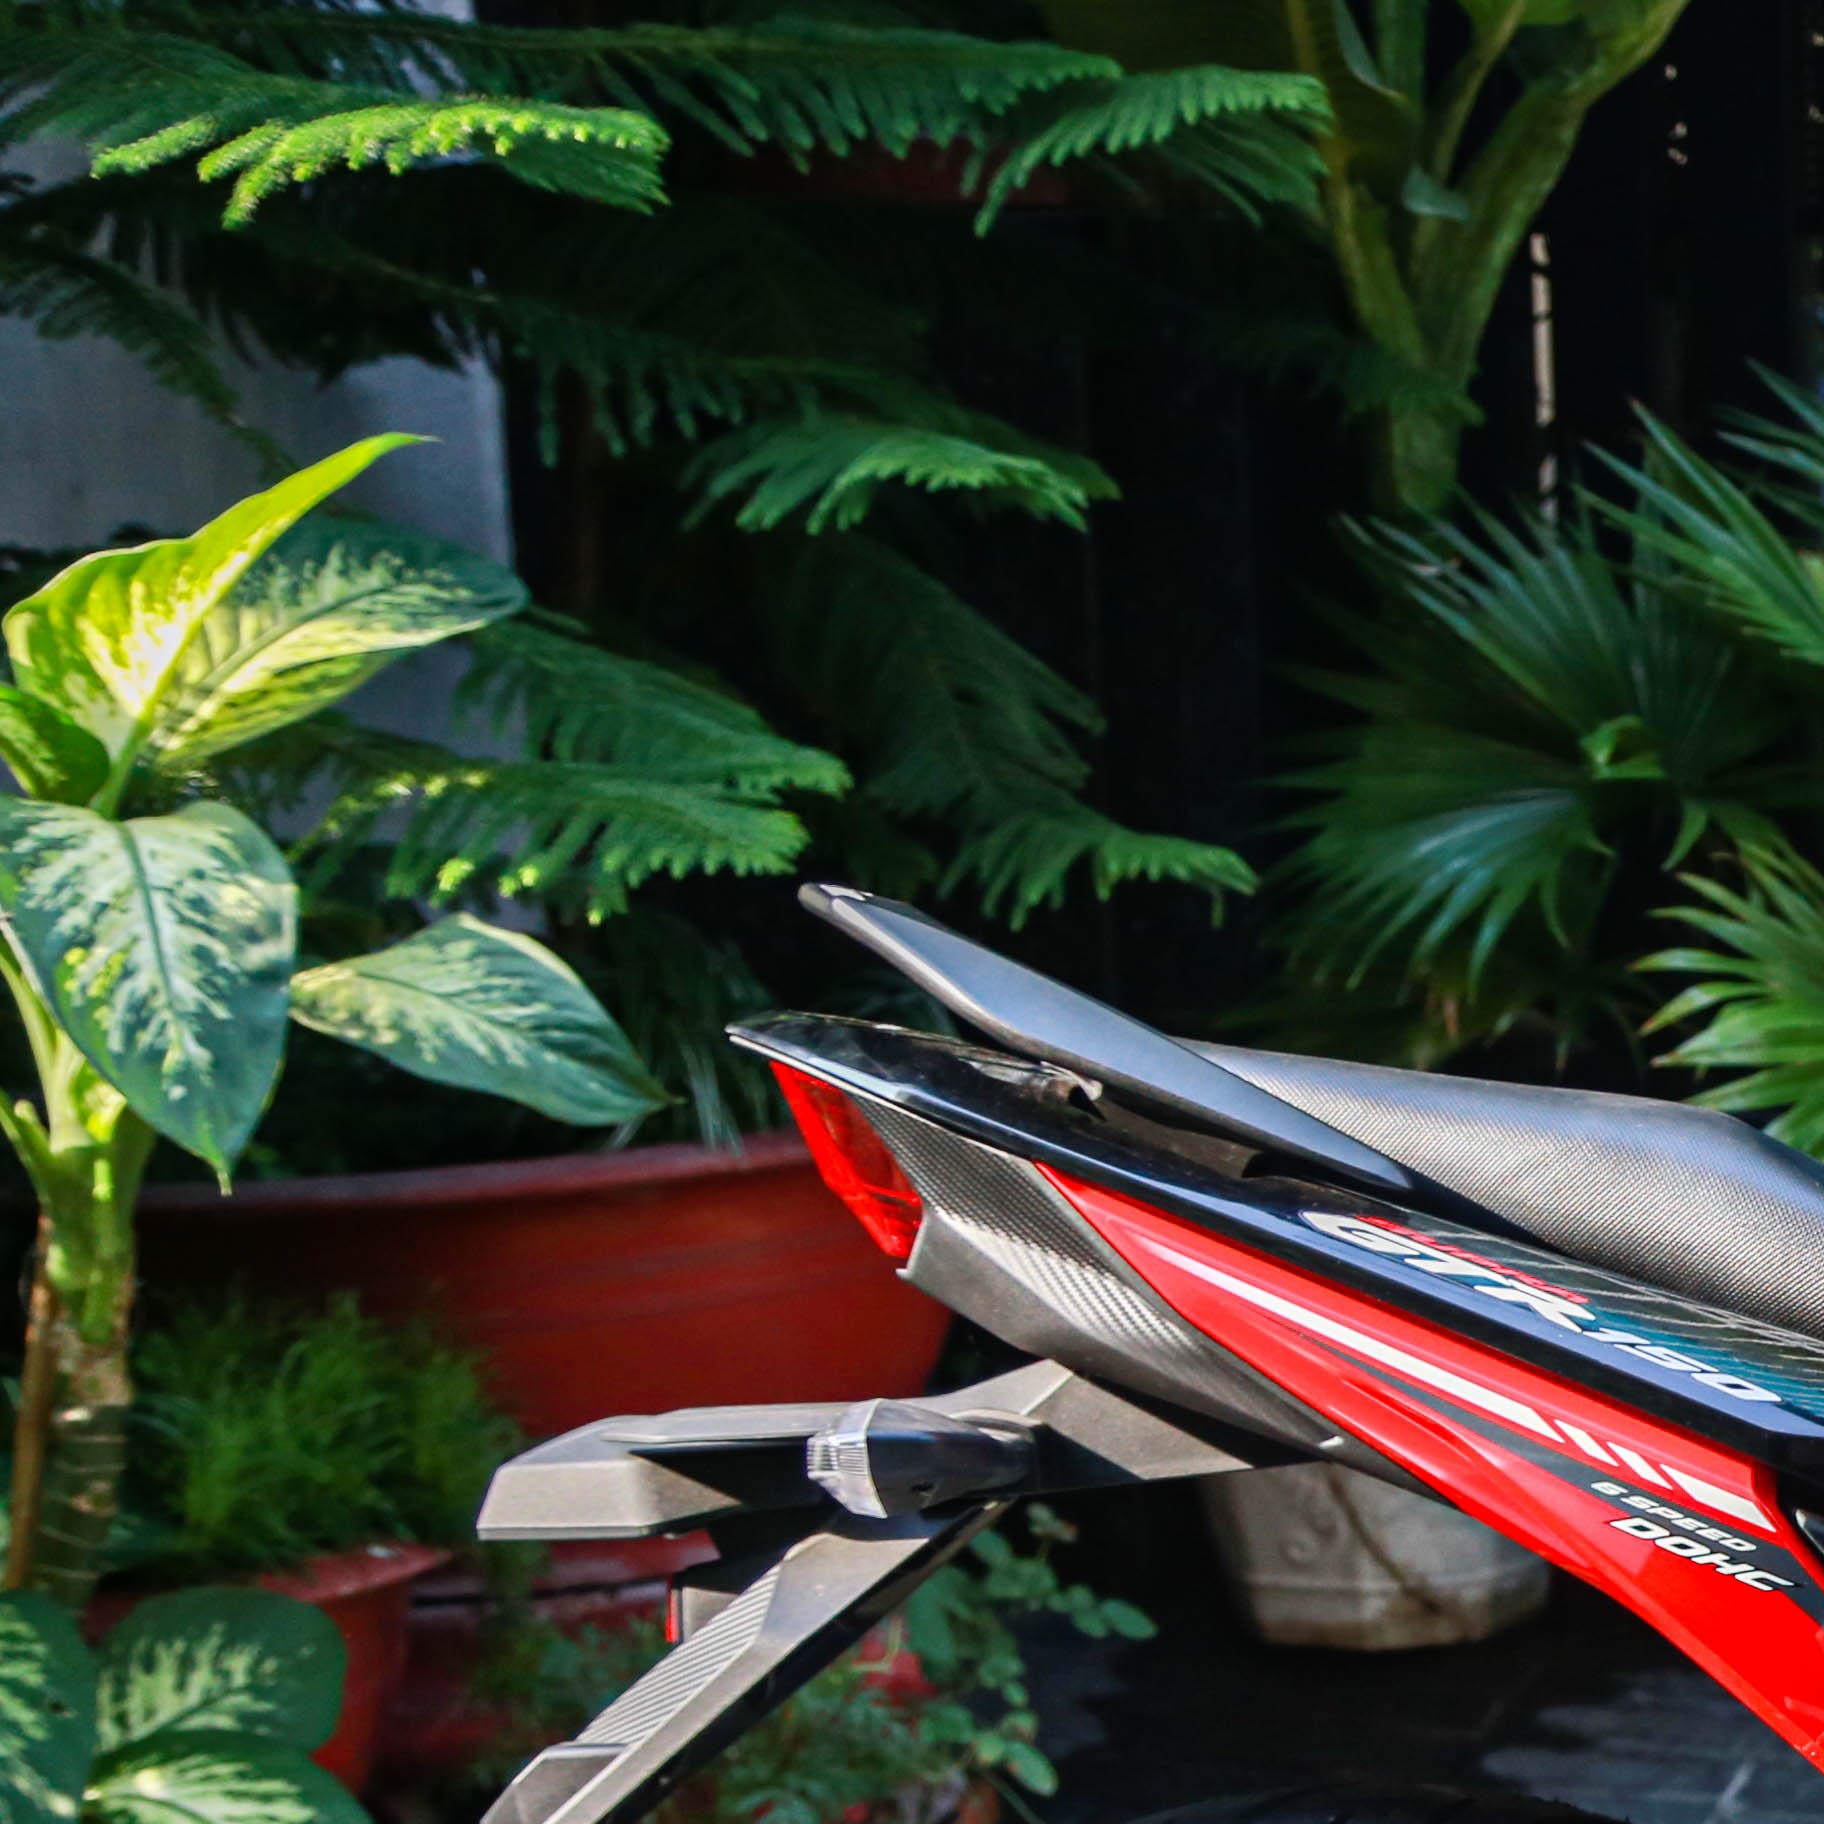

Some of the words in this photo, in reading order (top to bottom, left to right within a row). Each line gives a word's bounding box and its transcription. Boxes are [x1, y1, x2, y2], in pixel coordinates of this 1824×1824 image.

[1301, 1211, 1596, 1334] GTR
[1584, 1327, 1782, 1402] 150
[1590, 1481, 1629, 1496] 6
[1620, 1496, 1757, 1552] SPEED
[1609, 1517, 1795, 1592] DOHC
